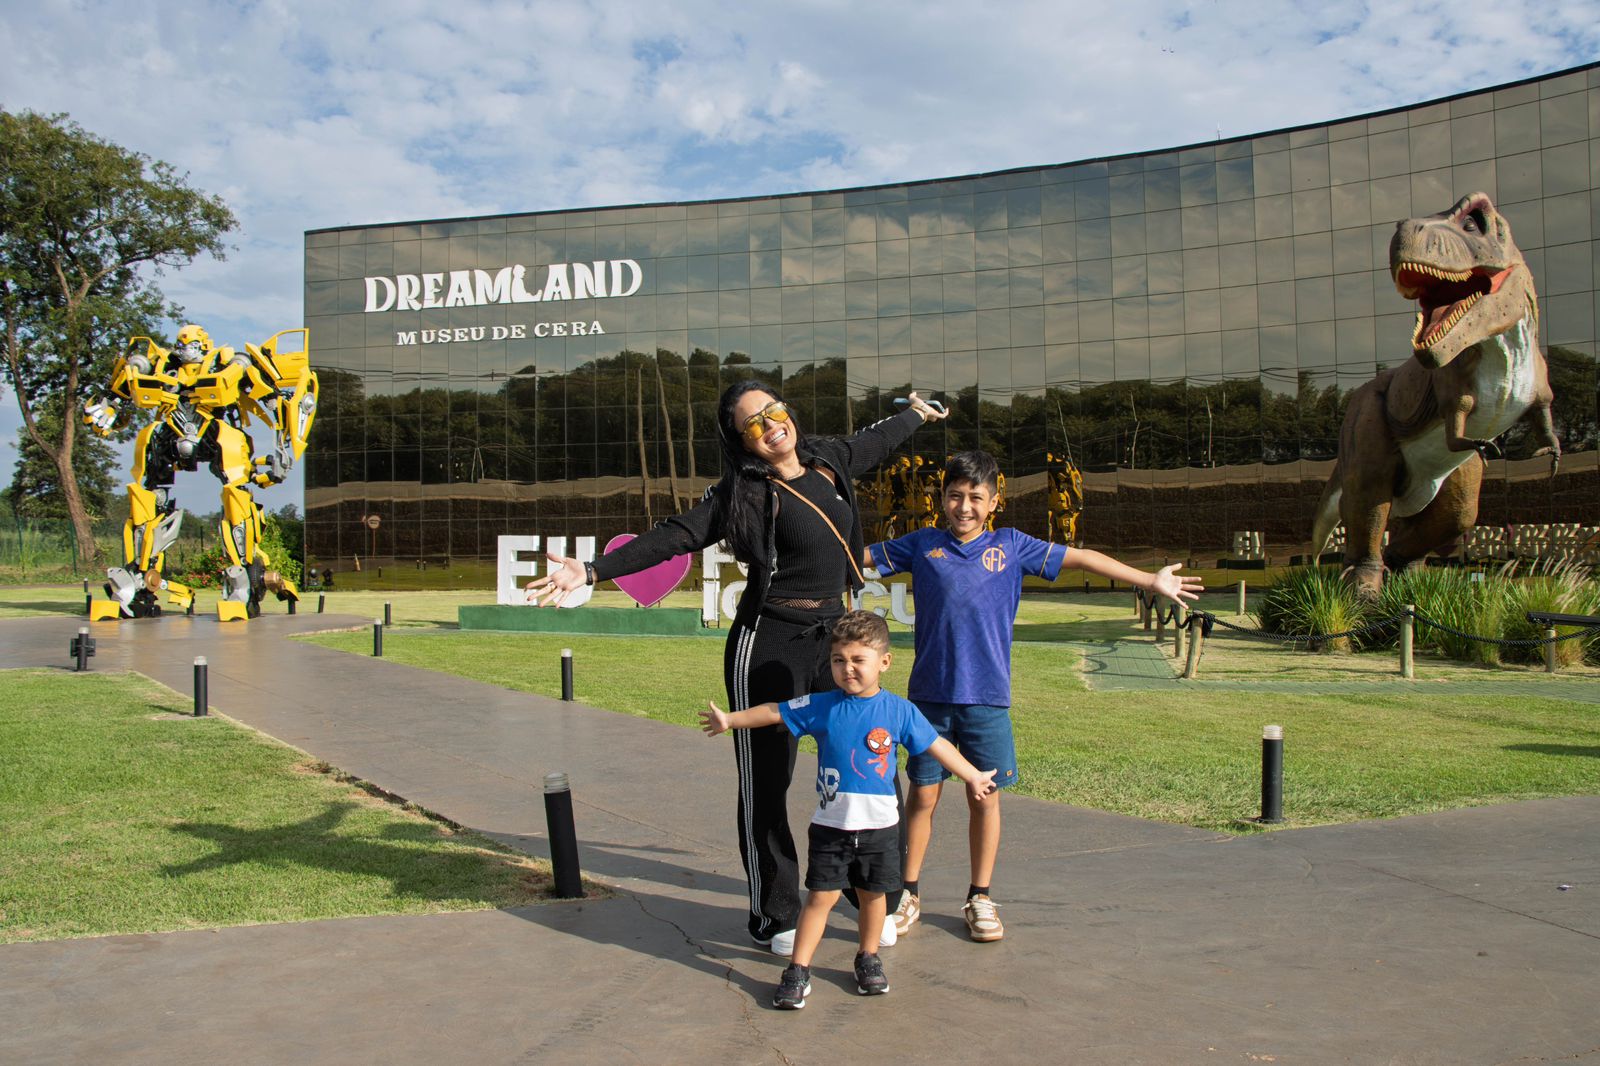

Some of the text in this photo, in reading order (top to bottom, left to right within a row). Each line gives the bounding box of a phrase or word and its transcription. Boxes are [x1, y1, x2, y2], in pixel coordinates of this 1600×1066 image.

[364, 259, 643, 312] DREAMLAND
[396, 320, 606, 346] MUSEU DE CERA
[497, 535, 595, 608] EU
